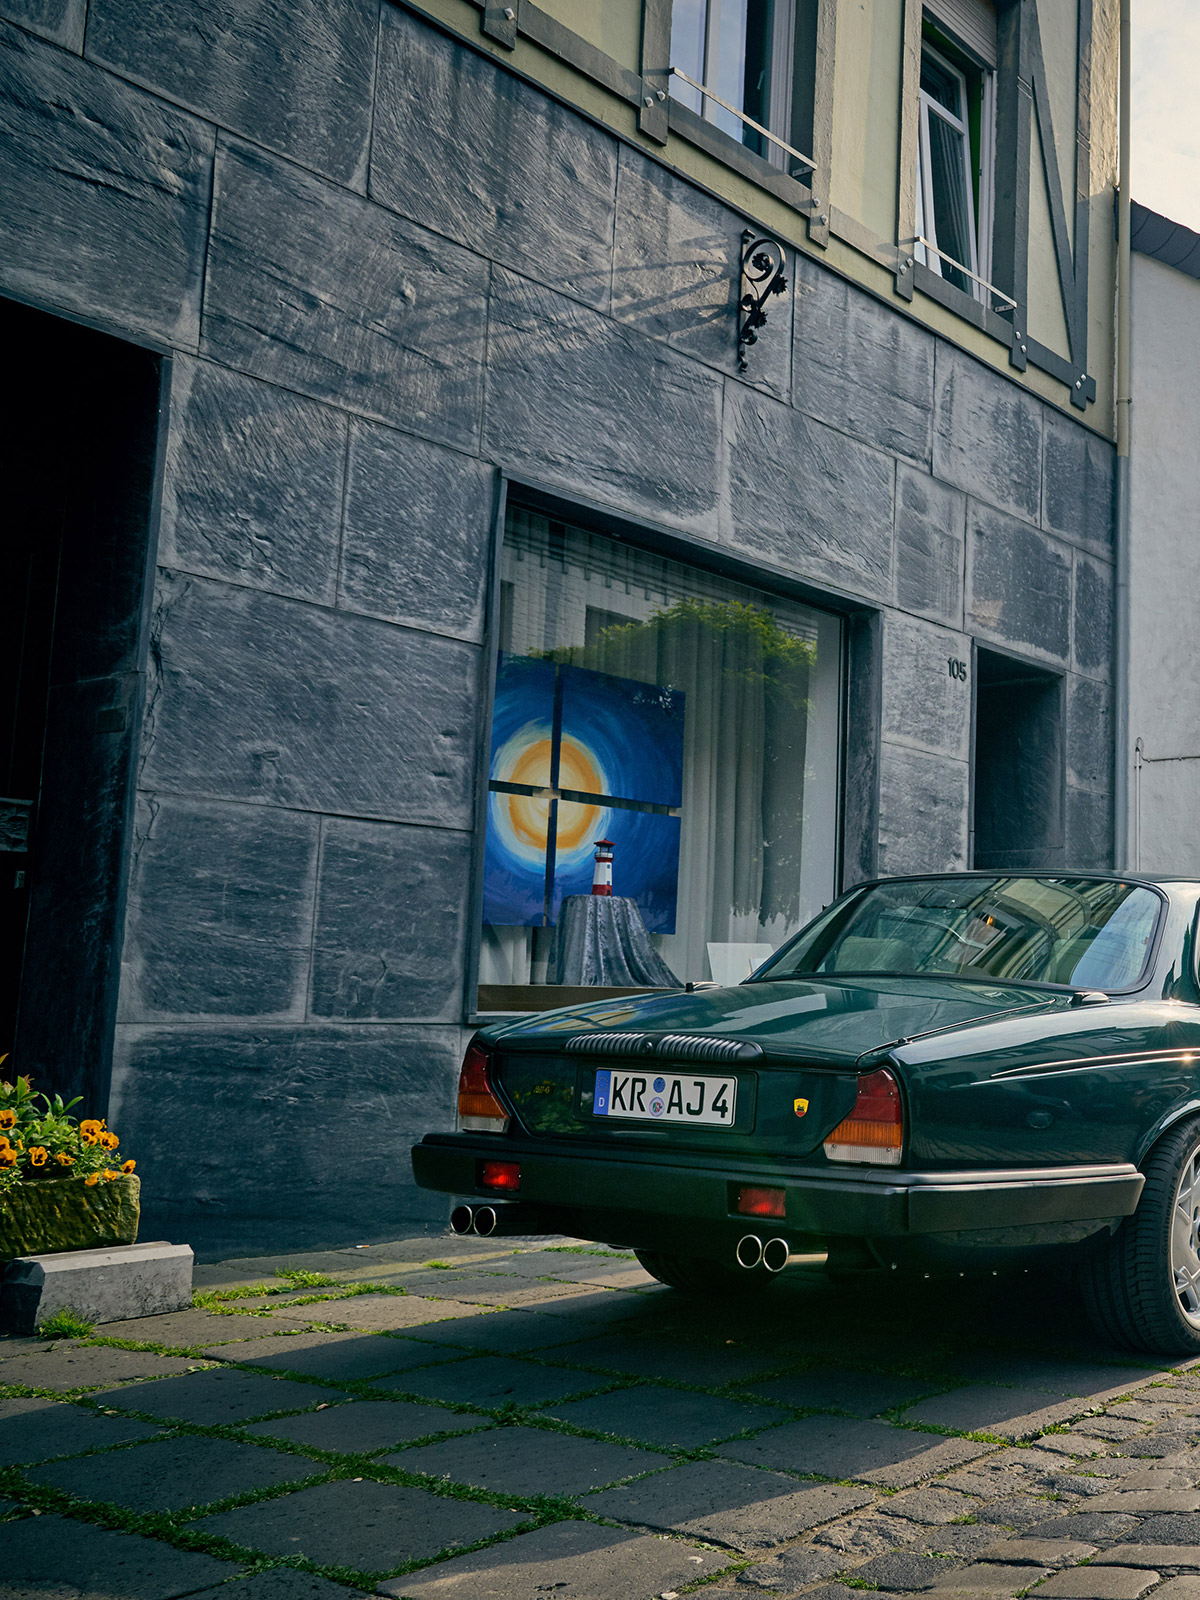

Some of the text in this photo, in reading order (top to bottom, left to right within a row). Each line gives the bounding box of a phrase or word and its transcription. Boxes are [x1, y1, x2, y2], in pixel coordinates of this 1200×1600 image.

[947, 656, 967, 682] 105
[598, 1097, 605, 1107] D
[611, 1076, 729, 1119] KR AJ 4
